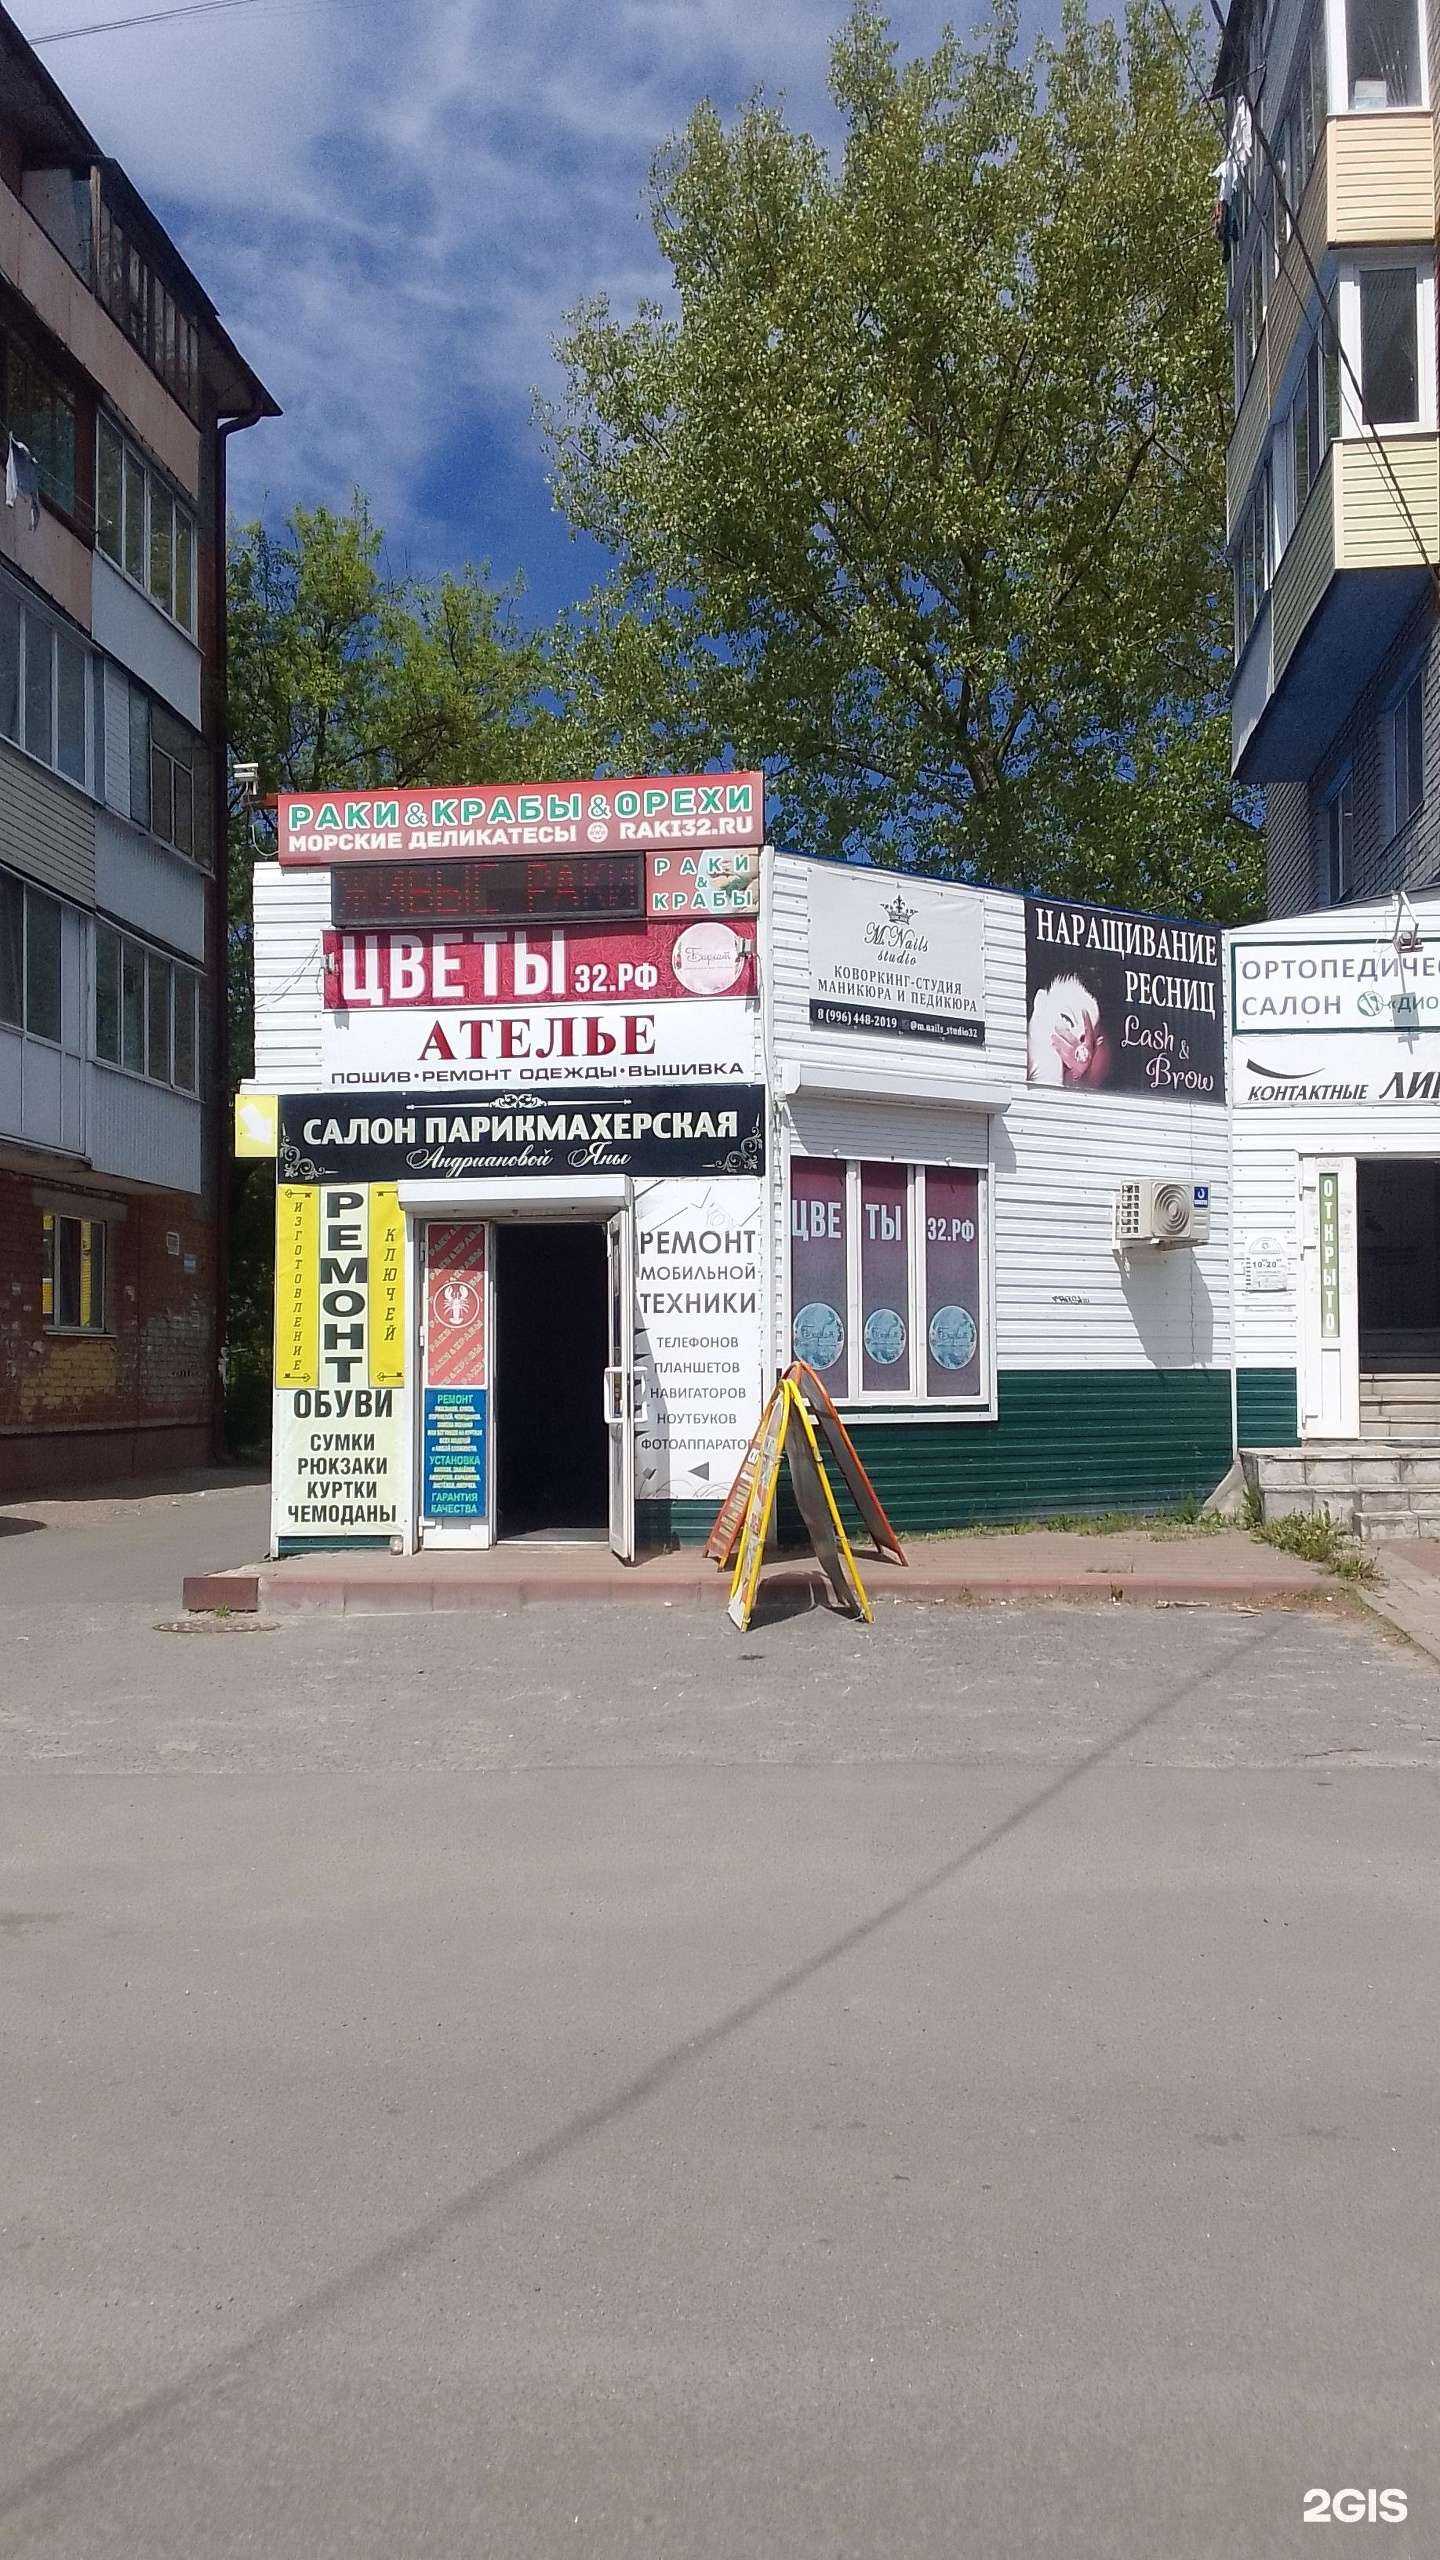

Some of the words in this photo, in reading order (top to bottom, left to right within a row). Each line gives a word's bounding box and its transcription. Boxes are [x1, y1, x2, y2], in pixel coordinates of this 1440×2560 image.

[289, 801, 399, 831] РАКИ
[432, 794, 582, 828] КРАБЫ
[615, 785, 753, 818] ОРЕХИ
[289, 831, 402, 852] МОРСКИЕ
[409, 826, 577, 850] ДЕЛИКАТЕСЫ
[620, 816, 753, 840] RAKI32.RU
[654, 855, 749, 876] РАКИ
[696, 876, 708, 889] &
[653, 890, 752, 911] КРАБЫ
[1035, 907, 1218, 967] НАРАЩИВАНИЕ
[342, 930, 567, 1005] ЦВЕТЫ
[575, 963, 659, 993] 32.РФ
[877, 949, 917, 966] studio
[834, 965, 962, 995] КОВОРКИНГ-СТУДИЯ
[1242, 957, 1440, 983] ОРТОПЕДИЧЕ
[818, 979, 891, 1001] МАНИКЮРА
[898, 989, 905, 1002] И
[911, 992, 977, 1013] ПЕДИКЮРА
[1124, 970, 1216, 1020] РЕСНИЦ
[1242, 995, 1341, 1016] САЛОН
[817, 1009, 824, 1020] 8
[826, 1010, 851, 1026] (996)
[853, 1012, 898, 1029] 448-2019
[417, 1014, 656, 1061] АТЕЛЬЕ
[1120, 1014, 1175, 1052] Lash
[1179, 1039, 1190, 1060] &
[332, 1071, 411, 1085] ПОШИВ
[422, 1069, 513, 1082] РЕМОНТ
[520, 1065, 617, 1081] ОДЕЖДЫ
[628, 1063, 744, 1077] ВЫШИВКА
[1145, 1053, 1215, 1092] Brow
[1248, 1084, 1369, 1101] КОНТАКТНЫЕ
[1379, 1071, 1440, 1099] ЛИ
[303, 1117, 416, 1145] САЛОН
[425, 1111, 738, 1143] ПАРИКМАХЕРСКАЯ
[406, 1144, 555, 1178] Андриановой
[567, 1141, 633, 1168] Яны
[792, 1200, 842, 1241] ЦВЕ
[865, 1204, 902, 1241] ТЫ
[927, 1218, 975, 1243] 32.РФ
[640, 1230, 756, 1254] РЕМОНТ
[1323, 1179, 1337, 1330] ОТКРЫТО
[640, 1263, 756, 1281] МОБИЛЬНОЙ
[292, 1201, 303, 1371] ИЗГОТОВЛЕНИЕ
[320, 1191, 368, 1383] РЕМОНТ
[382, 1228, 398, 1341] КЛЮЧЕЙ
[640, 1293, 756, 1314] ТЕХНИКИ
[656, 1336, 739, 1349] ТЕЛЕФОНОВ
[654, 1362, 740, 1374] ПЛАНШЕТОВ
[293, 1389, 393, 1418] ОБУВИ
[437, 1394, 474, 1405] РЕМОНТ
[650, 1387, 746, 1399] НАВИГАТОРОВ
[657, 1413, 737, 1425] НОУТБУКОВ
[310, 1433, 375, 1451] СУМКИ
[641, 1438, 747, 1450] ФОТОАППАРАТО
[297, 1457, 388, 1475] РЮКЗАКИ
[429, 1456, 481, 1465] УСТАНОВКА
[307, 1481, 377, 1499] КУРТКИ
[431, 1492, 478, 1502] ГАРАНТИЯ
[288, 1505, 397, 1525] ЧЕМОДАНЫ
[431, 1503, 478, 1513] КАЧЕСТВА
